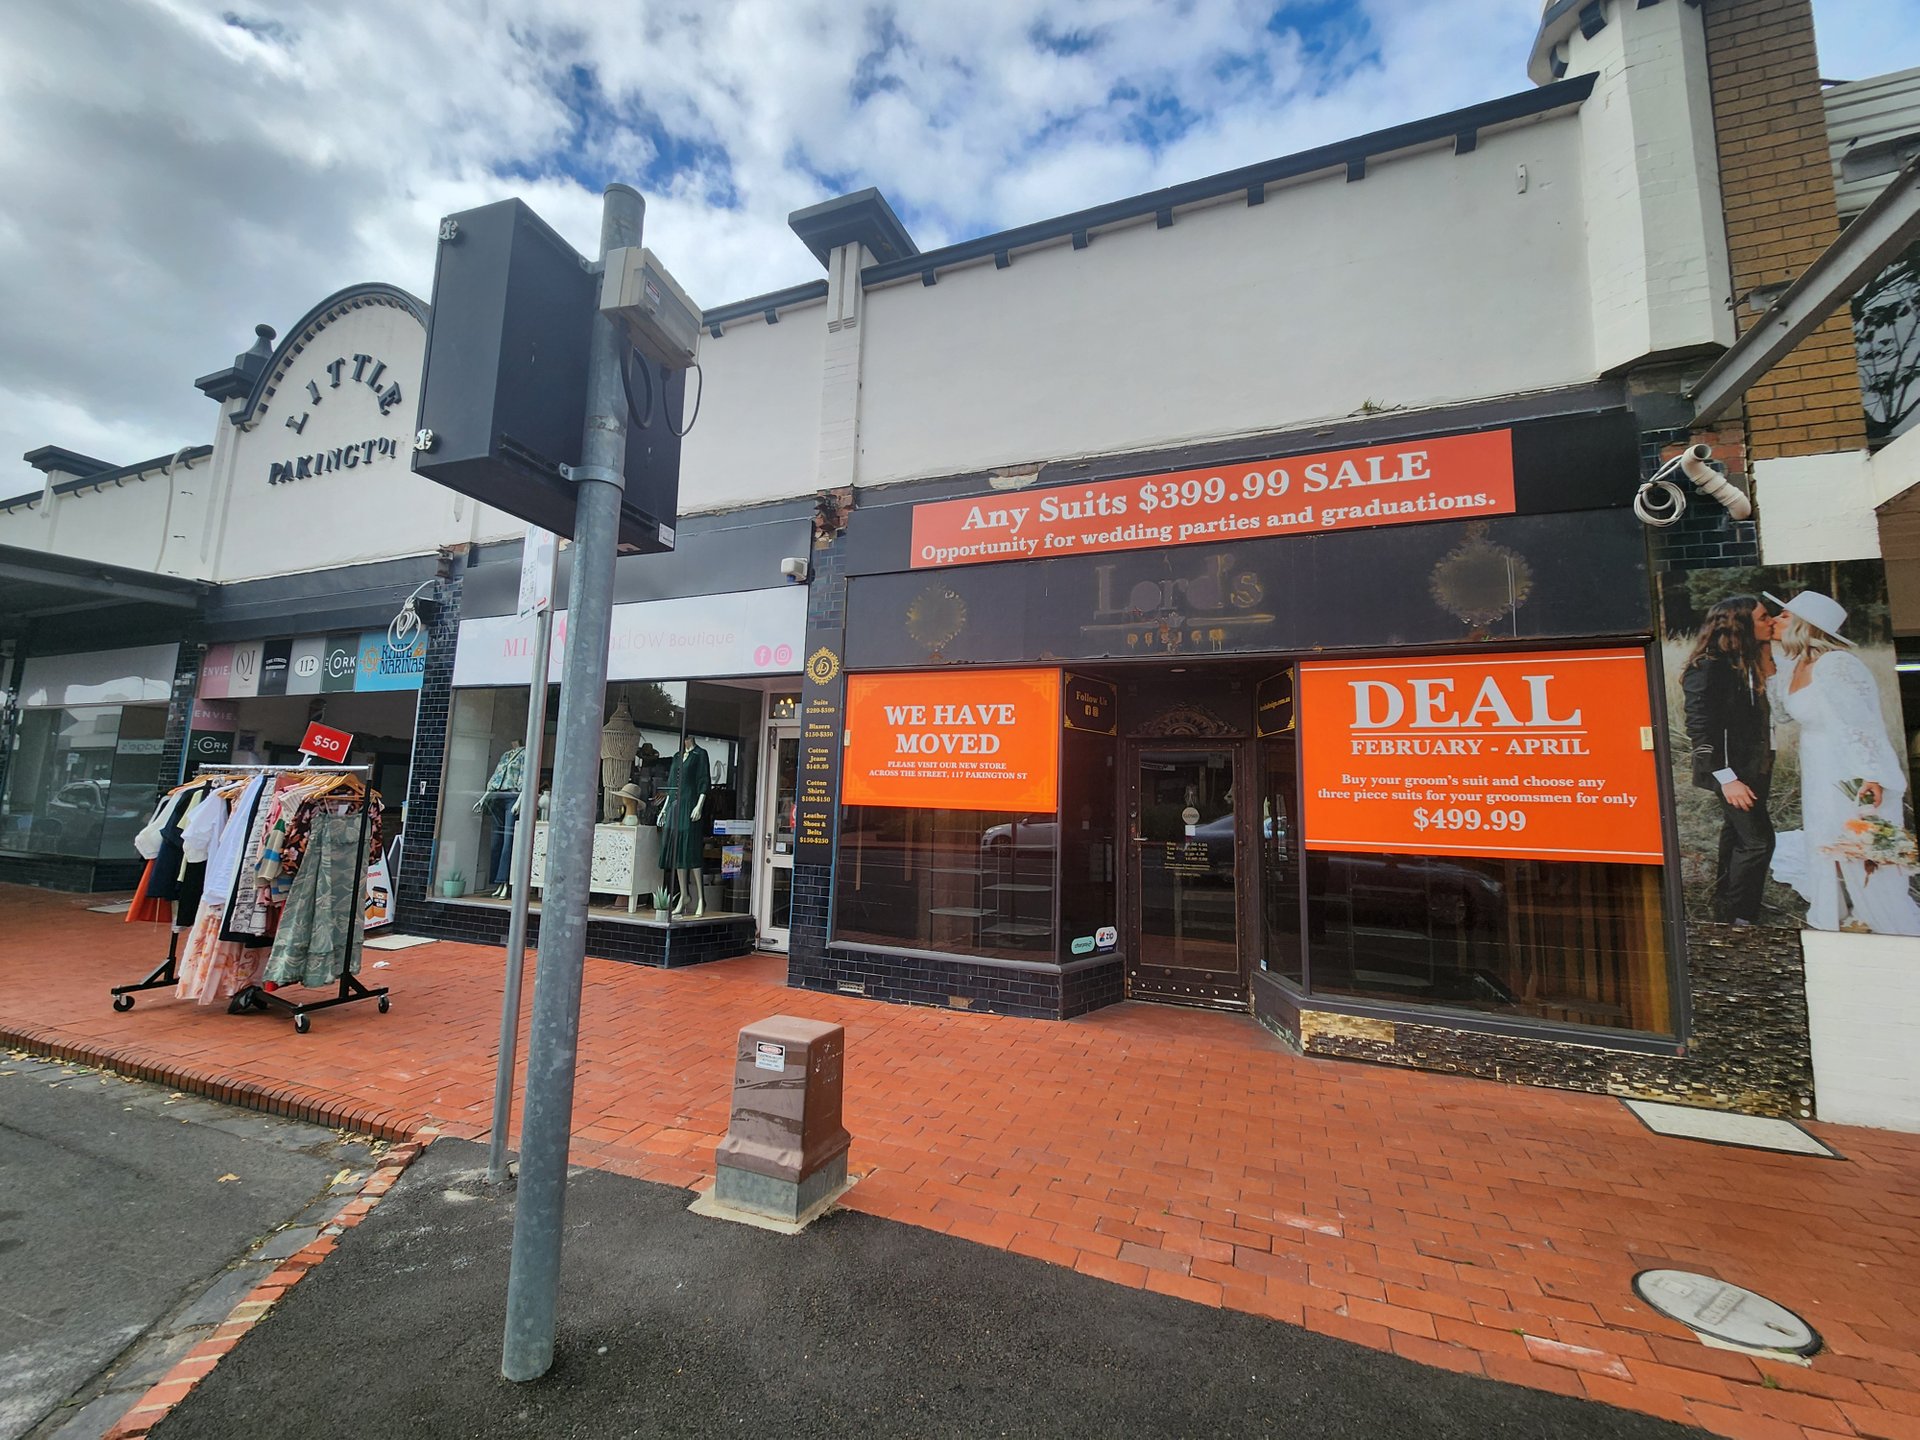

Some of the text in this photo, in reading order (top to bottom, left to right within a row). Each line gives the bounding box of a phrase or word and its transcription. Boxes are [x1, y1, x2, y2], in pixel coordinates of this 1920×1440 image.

[285, 353, 402, 435] LITTLE
[961, 451, 1431, 533] Any Suits $399.99 SALE
[921, 491, 1496, 562] Opportunity for wedding parties and graduations.
[503, 637, 535, 657] MI
[668, 631, 735, 650] Boutique
[203, 665, 231, 676] ENVIE.
[299, 659, 315, 672] 112
[329, 649, 356, 678] CORK
[379, 657, 425, 674] MARINAS
[1076, 690, 1099, 703] Follow
[1348, 675, 1582, 728] DEAL
[194, 710, 237, 720] ENVIE.
[884, 704, 1016, 726] WE HAVE
[198, 736, 228, 753] CORK
[313, 735, 339, 751] $50
[895, 733, 1000, 754] MOVED
[1350, 739, 1484, 755] FEBRUARY
[1505, 738, 1590, 755] APRIL
[809, 755, 827, 763] Jeans
[917, 761, 937, 769] VISIT
[979, 762, 1007, 770] STORE
[869, 769, 899, 777] ACROSS
[918, 770, 950, 779] STREET,
[965, 771, 1015, 779] PAKINGTON
[1016, 772, 1028, 780] ST
[1342, 774, 1606, 790] Buy your groom's suit and choose any
[1318, 788, 1638, 807] three piece suits for your groomsmen for only
[1413, 807, 1527, 831] $499.99
[1106, 930, 1114, 940] zip
